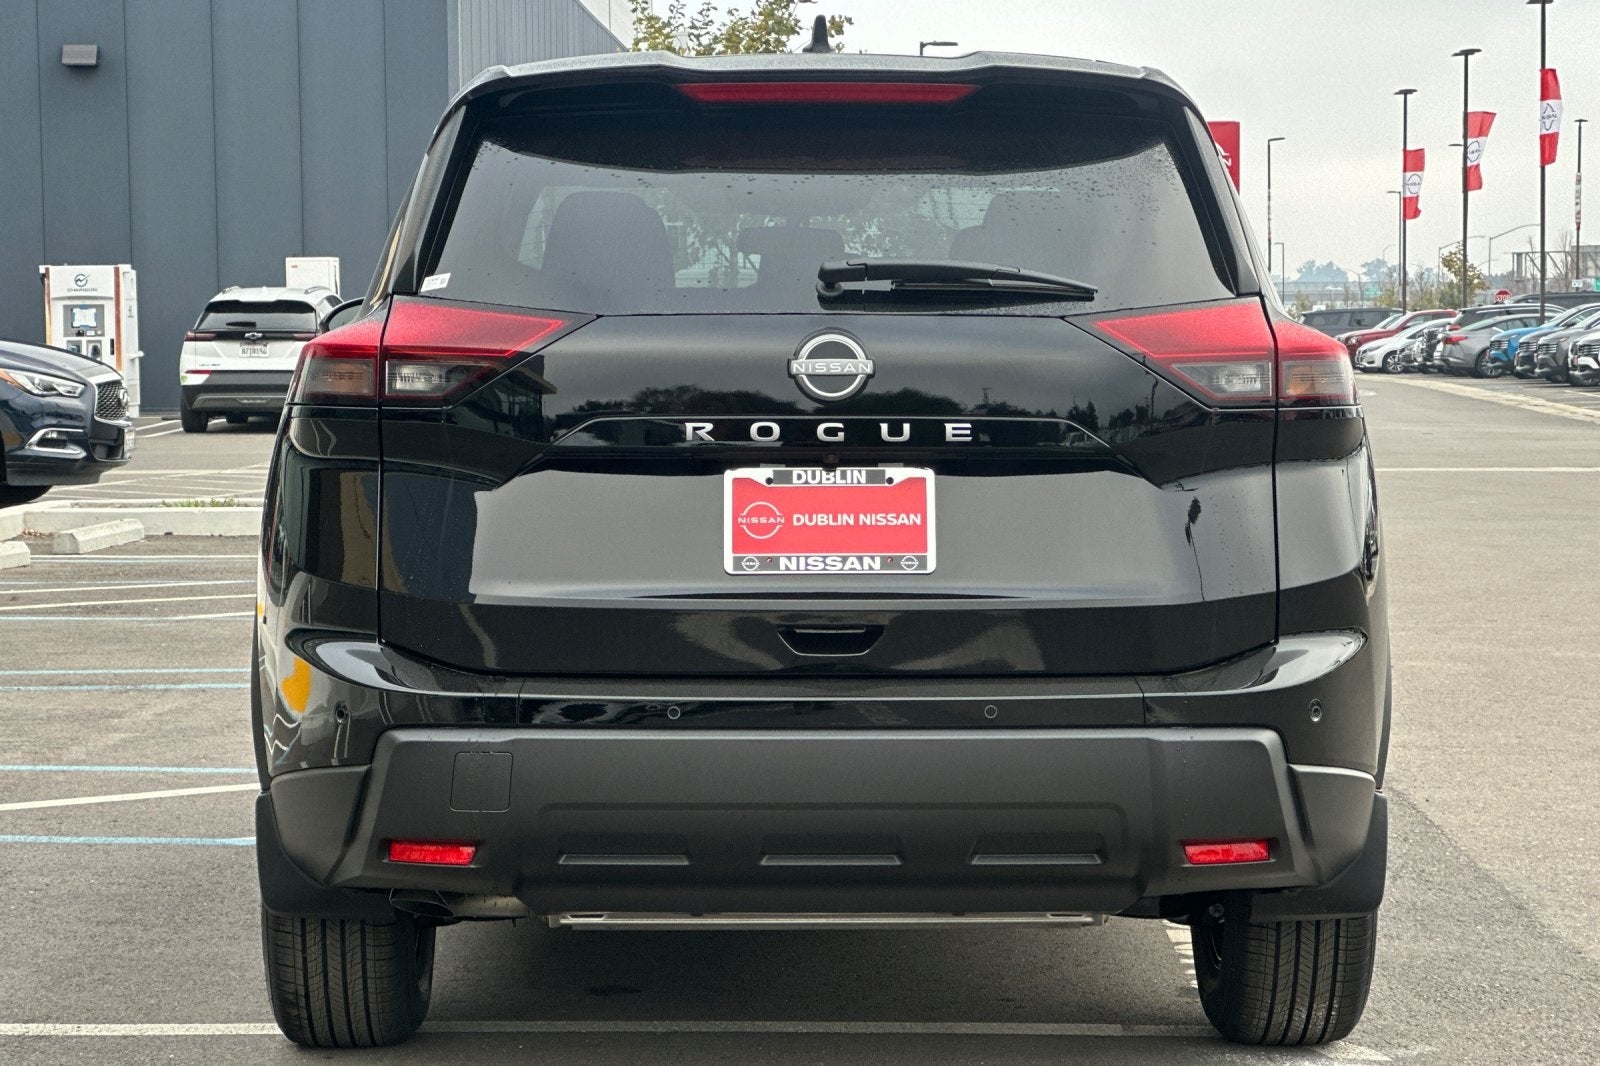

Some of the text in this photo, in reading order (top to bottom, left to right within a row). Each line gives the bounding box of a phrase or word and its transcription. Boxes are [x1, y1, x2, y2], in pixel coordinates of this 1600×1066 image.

[1496, 294, 1511, 302] STOP
[793, 362, 871, 373] NISSAN
[684, 420, 973, 442] ROGUE
[792, 469, 866, 484] DUBLIN
[737, 516, 785, 524] NISSAN
[792, 513, 921, 526] DUBLIN NISSAN
[779, 556, 881, 571] NISSAN
